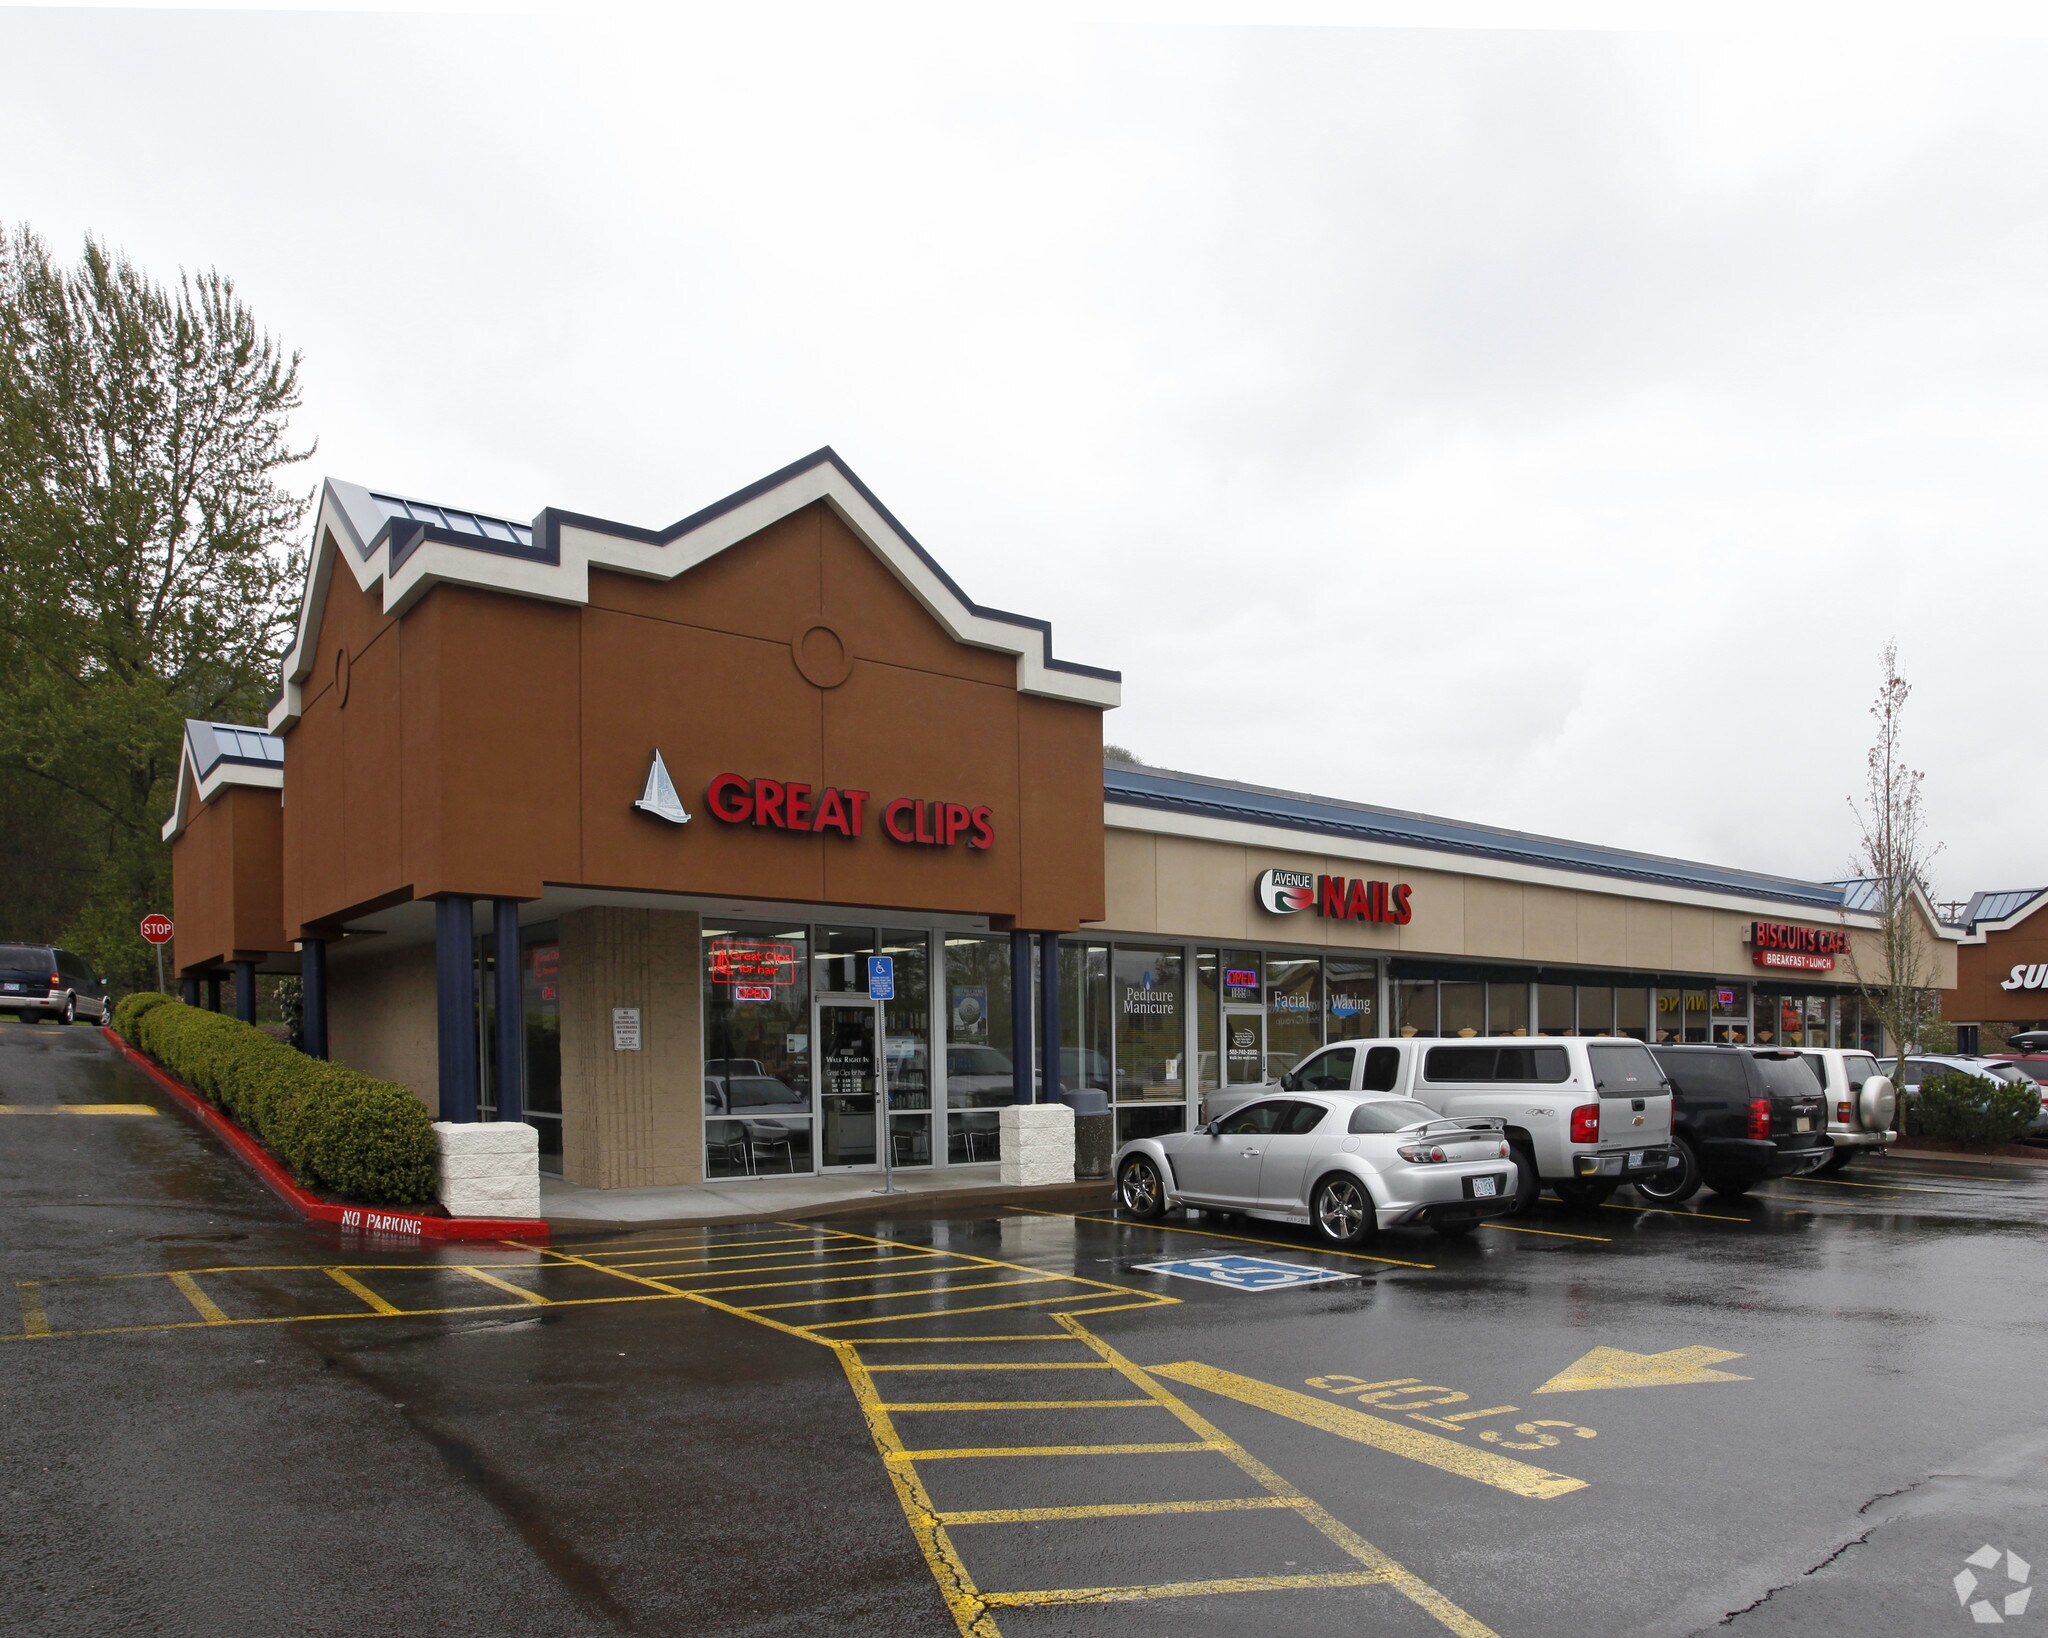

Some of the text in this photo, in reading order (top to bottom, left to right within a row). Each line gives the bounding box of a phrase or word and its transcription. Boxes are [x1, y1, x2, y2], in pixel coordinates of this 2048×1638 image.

[705, 772, 995, 850] GREAT CLIPS
[1274, 872, 1310, 888] AVENUE
[1319, 874, 1413, 925] NAILS
[143, 923, 172, 935] STOP
[1755, 922, 1817, 952] BISCUITS
[730, 949, 791, 964] Great Clips
[1766, 953, 1832, 969] BREAKFAST LUNCH
[738, 963, 779, 975] for hair
[1228, 971, 1255, 985] OPEN
[738, 988, 770, 999] OPEN
[1126, 987, 1174, 1002] Pedicure
[1274, 991, 1310, 1008] Facial
[1123, 1000, 1174, 1014] Manicure
[1331, 993, 1371, 1015] Waxing
[341, 1210, 422, 1235] NO PARKING
[1304, 1374, 1598, 1450] STOP
